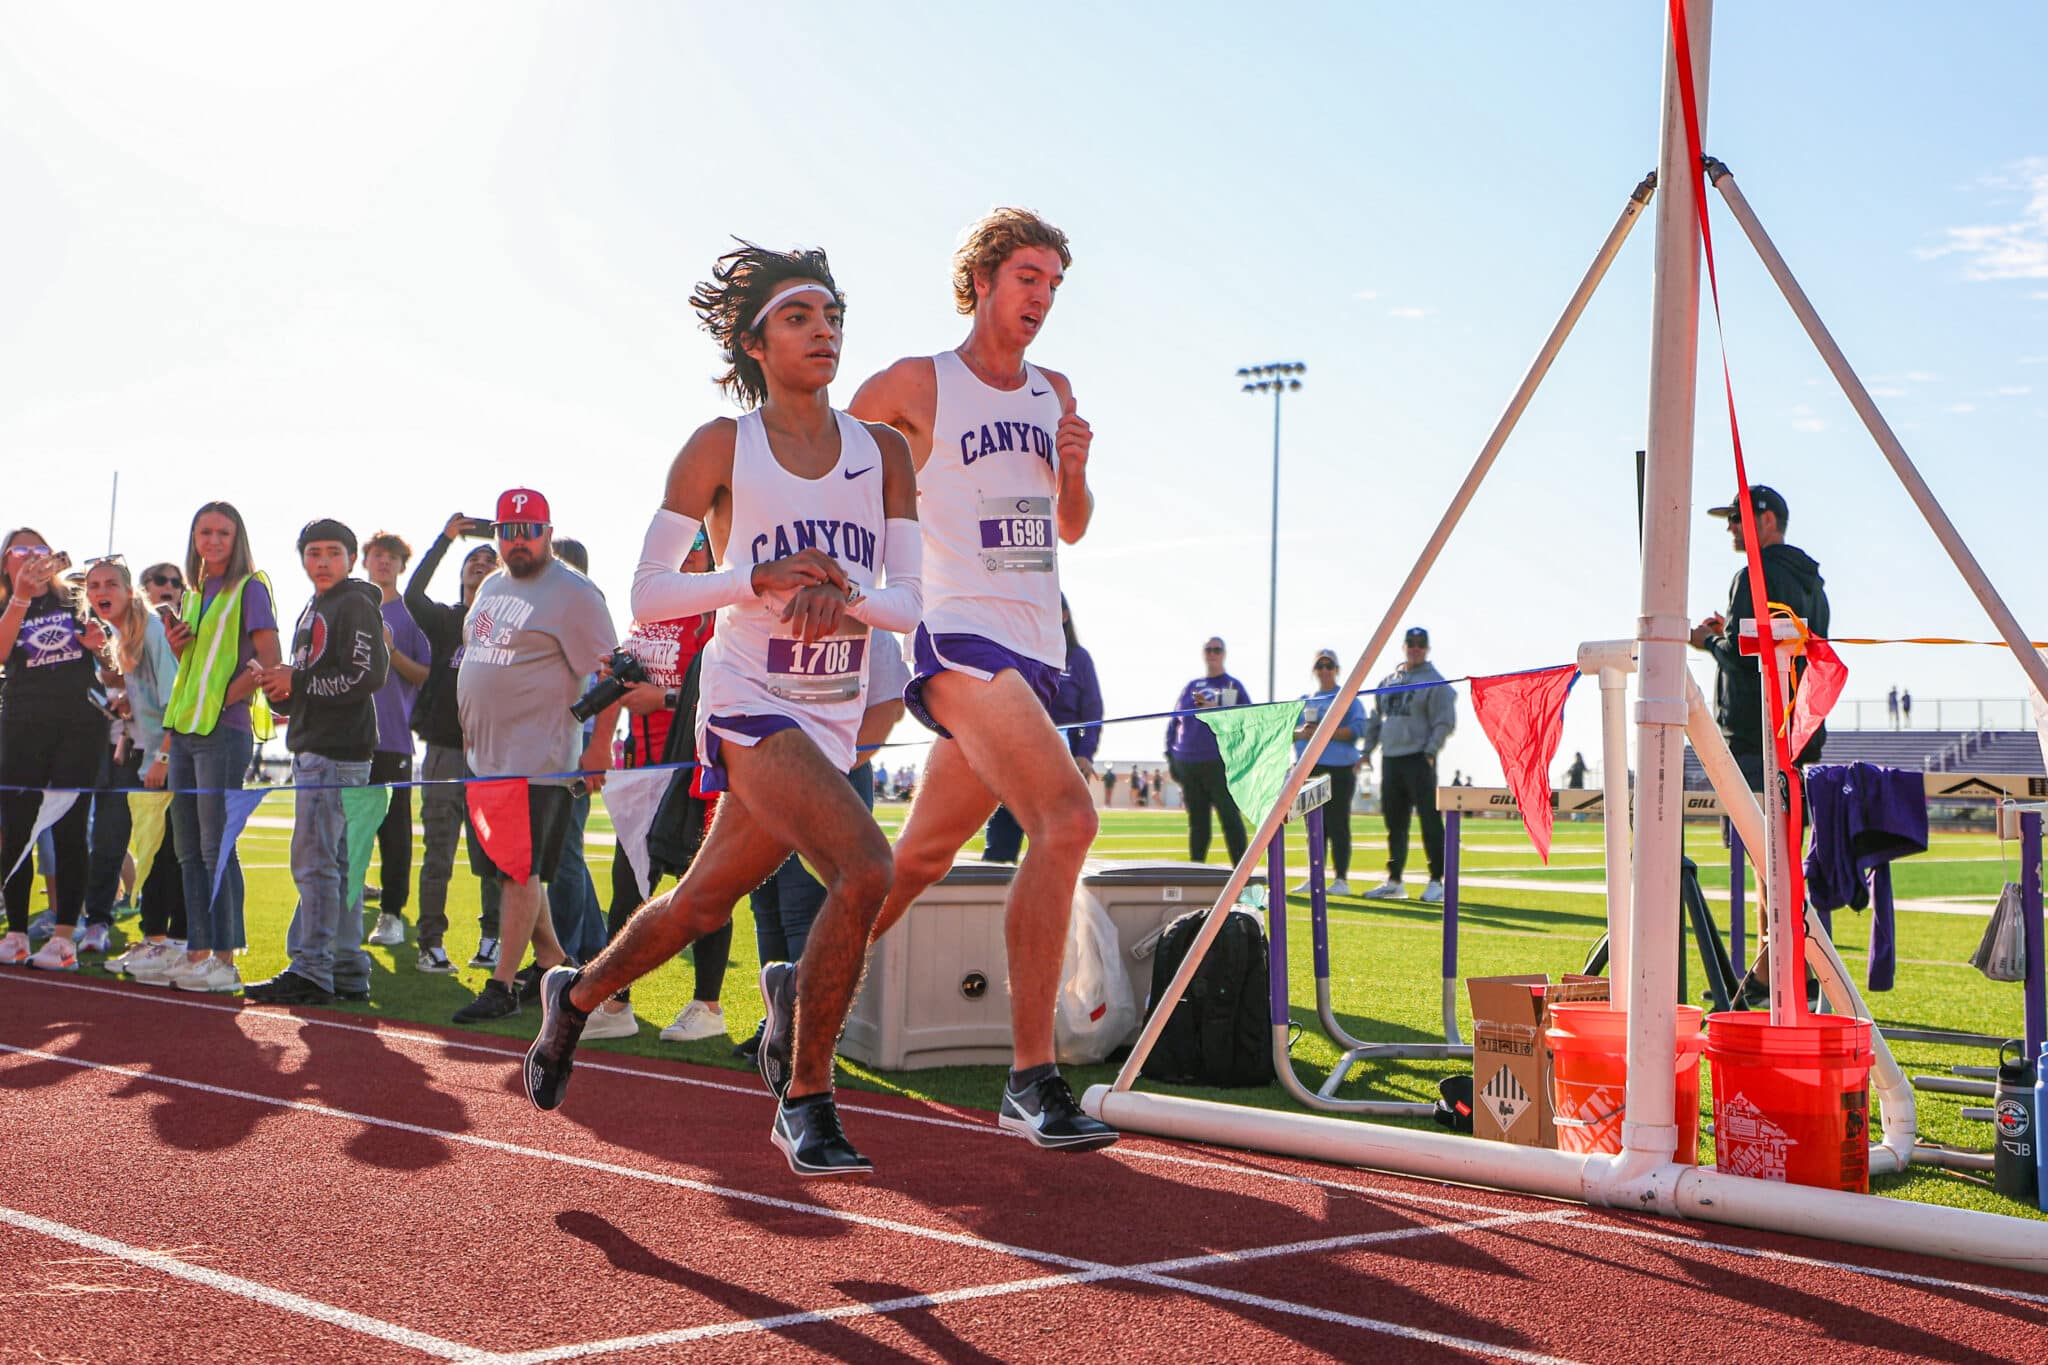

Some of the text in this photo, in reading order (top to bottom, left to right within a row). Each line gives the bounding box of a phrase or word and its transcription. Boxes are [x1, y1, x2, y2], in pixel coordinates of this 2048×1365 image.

[961, 421, 1053, 472] CANYON
[512, 494, 528, 513] P
[752, 519, 876, 572] CANYON
[998, 519, 1045, 546] 1698
[352, 630, 372, 671] LAZY
[495, 628, 512, 646] 25
[26, 650, 82, 668] EAGLES
[789, 641, 851, 674] 1708
[1687, 798, 1716, 809] GILL
